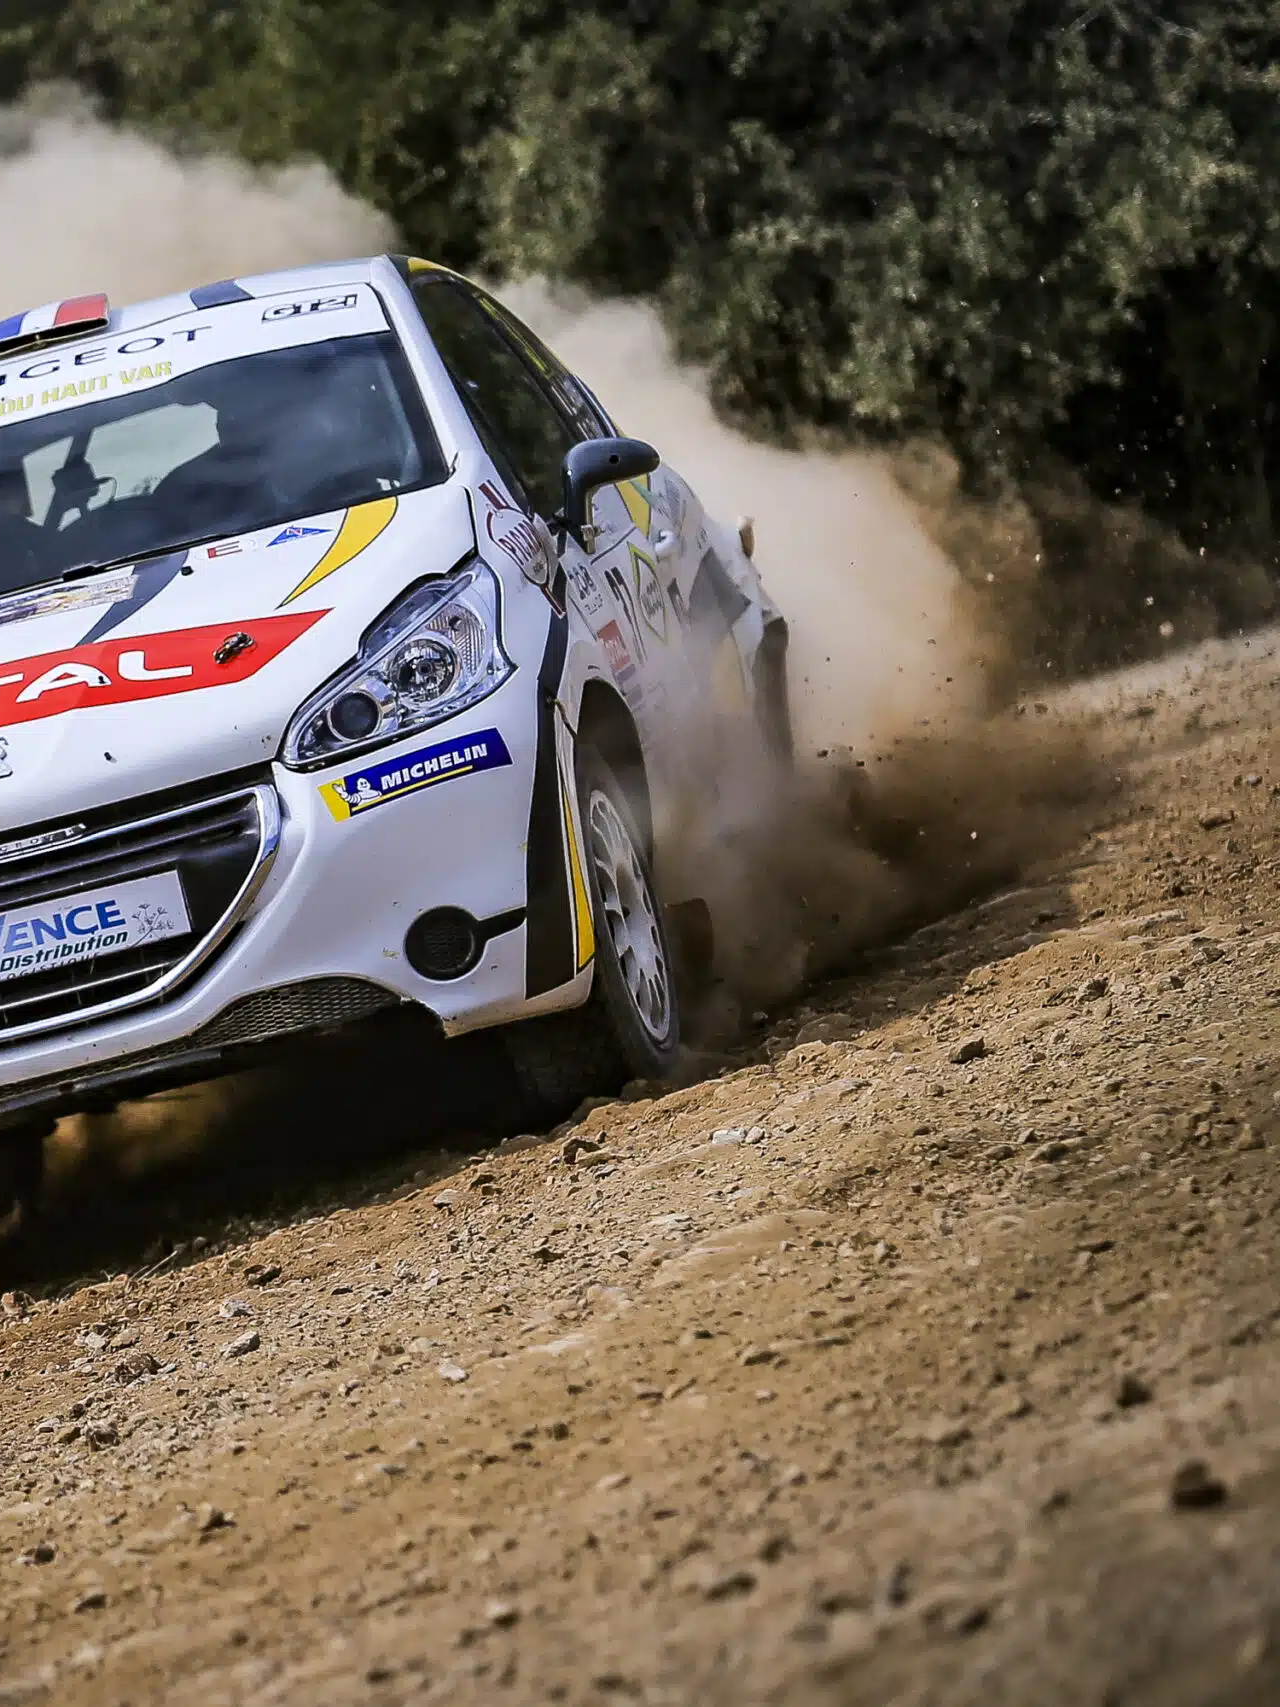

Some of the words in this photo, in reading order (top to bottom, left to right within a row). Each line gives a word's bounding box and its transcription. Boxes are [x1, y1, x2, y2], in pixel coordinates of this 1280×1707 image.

[42, 373, 113, 405] HAUT
[120, 361, 173, 385] VAR
[380, 743, 488, 791] MICHELIN
[0, 931, 129, 973] Distribution
